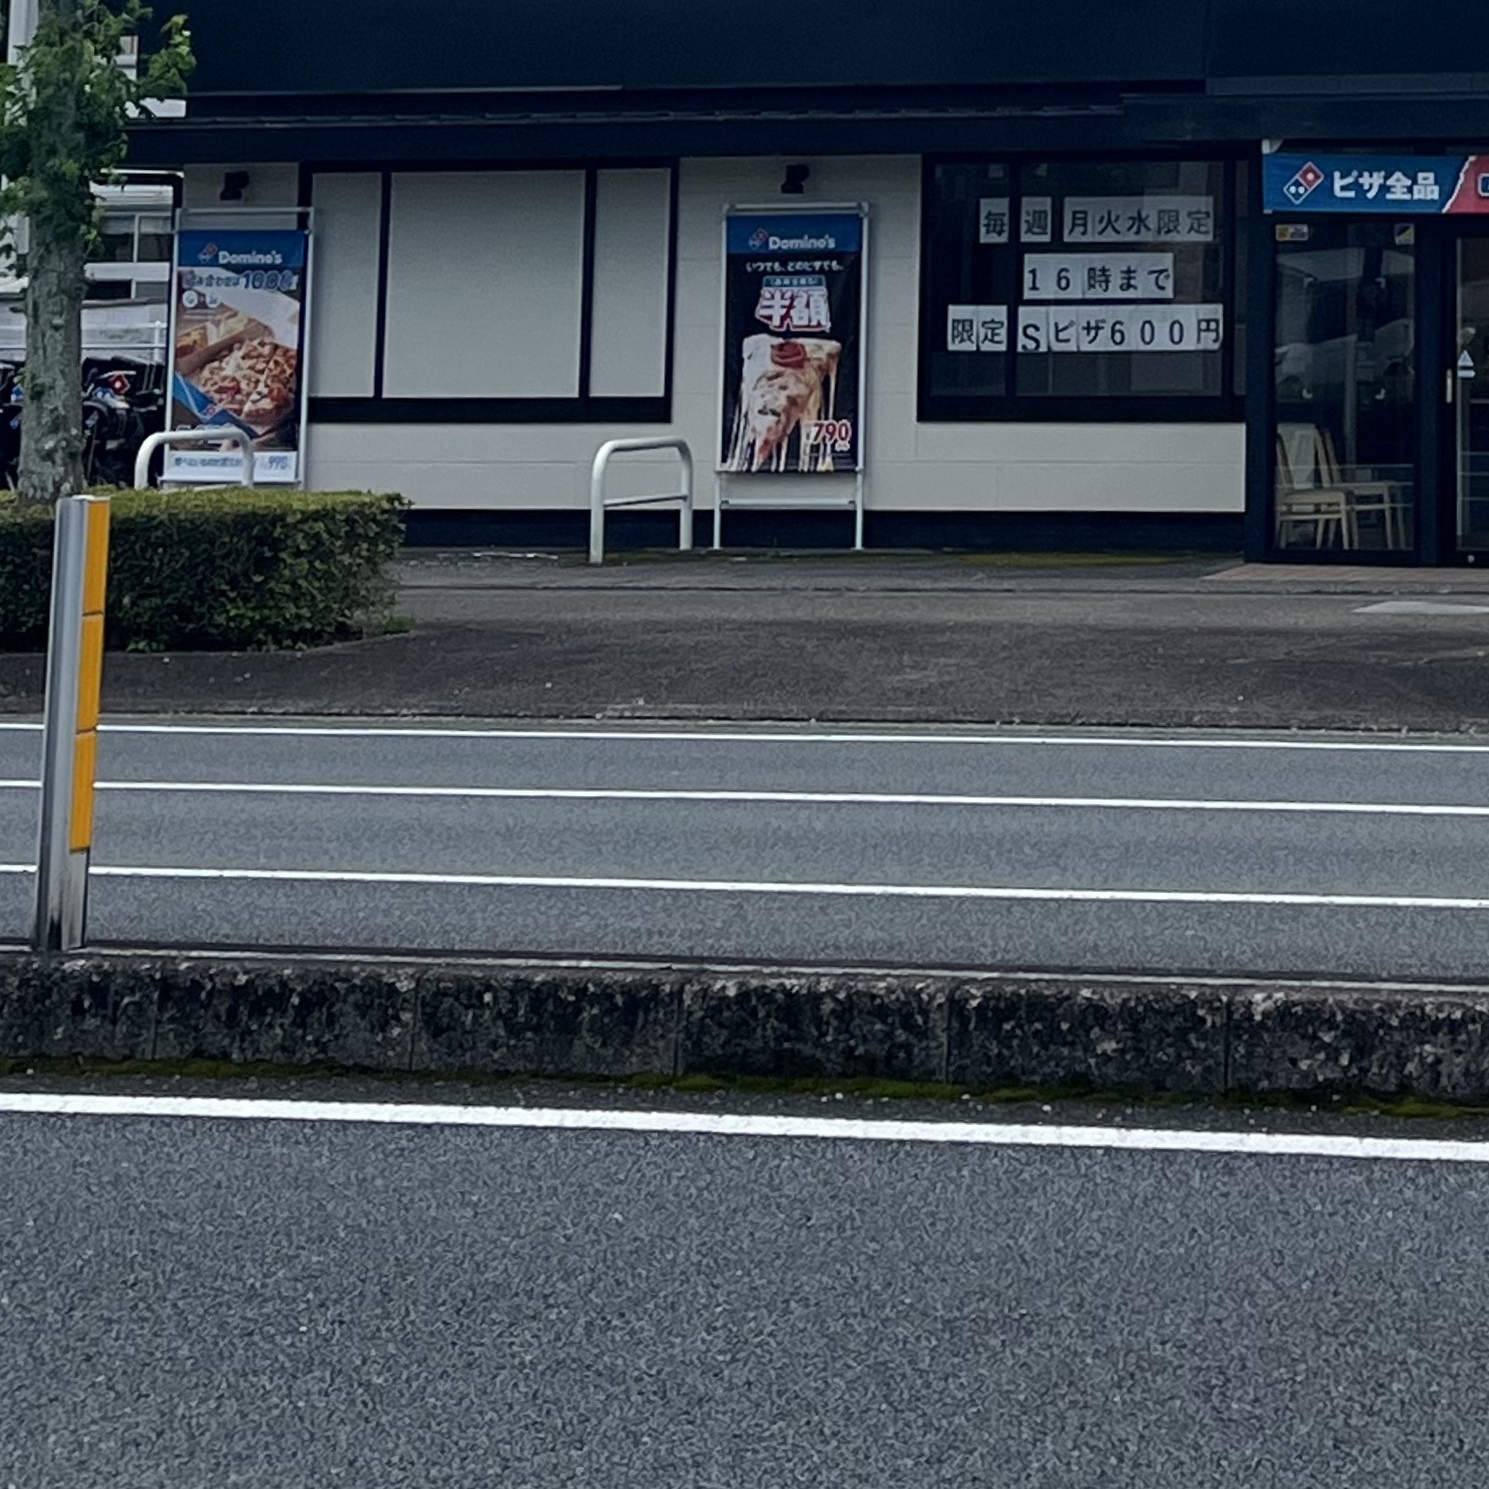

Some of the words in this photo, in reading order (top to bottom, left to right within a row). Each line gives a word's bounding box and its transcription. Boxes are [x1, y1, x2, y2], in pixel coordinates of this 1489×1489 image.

[1333, 169, 1440, 200] ピザ全品
[768, 234, 836, 251] Domino's
[218, 250, 283, 265] Domino's
[1028, 266, 1170, 293] 16時まで
[758, 289, 829, 328] 半額
